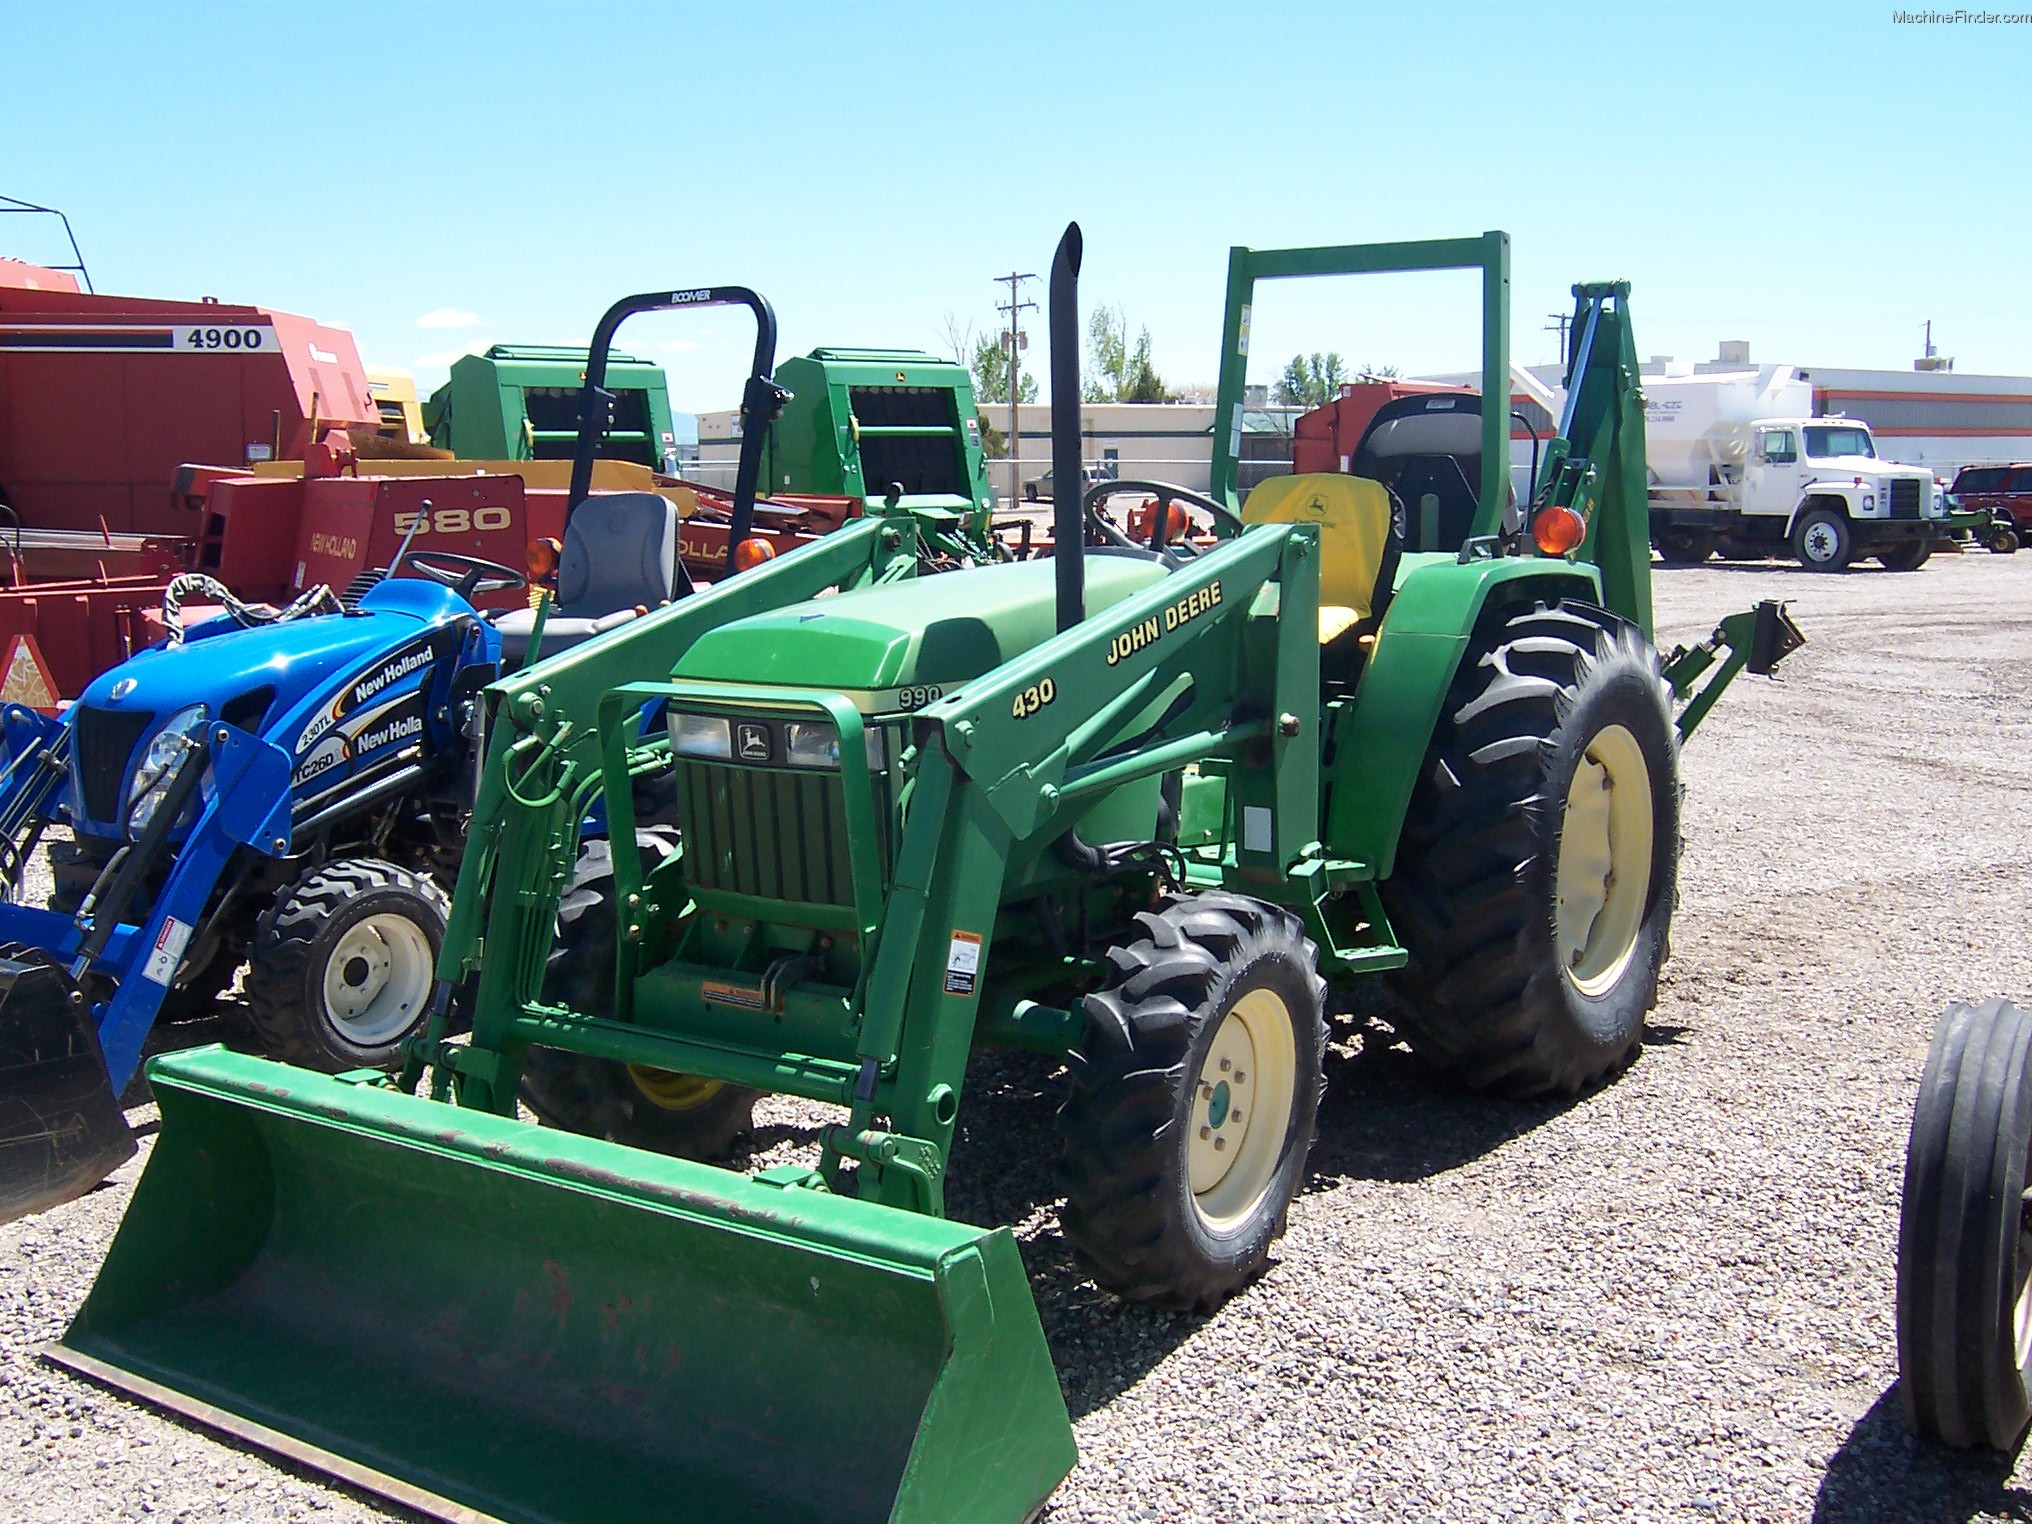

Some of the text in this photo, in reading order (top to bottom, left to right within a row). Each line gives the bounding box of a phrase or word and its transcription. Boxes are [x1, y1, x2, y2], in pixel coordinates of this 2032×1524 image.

[671, 289, 711, 304] BOOMER
[187, 328, 262, 349] 4900
[393, 506, 512, 536] 580
[1106, 579, 1223, 666] JOHN DEERE
[355, 645, 434, 703] New Holland
[899, 685, 942, 708] 990
[1011, 675, 1057, 720] 430
[301, 714, 332, 747] 230TL
[357, 729, 389, 755] New
